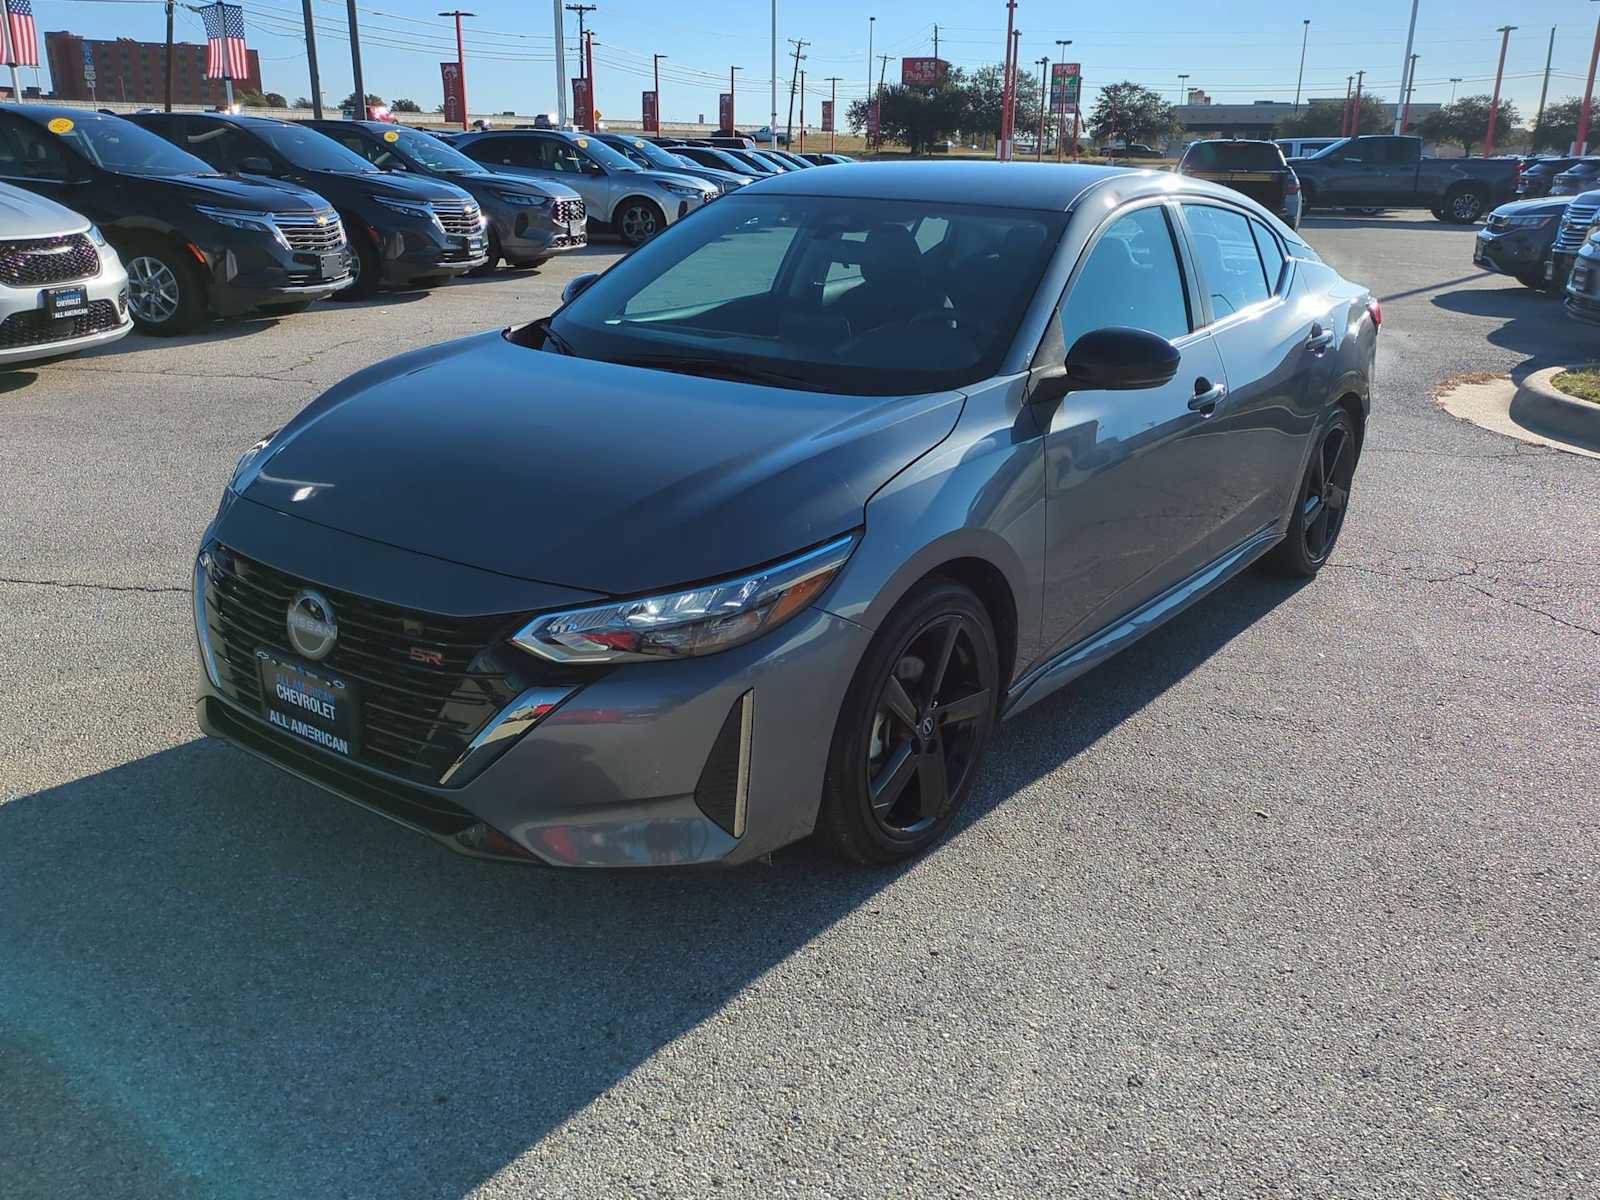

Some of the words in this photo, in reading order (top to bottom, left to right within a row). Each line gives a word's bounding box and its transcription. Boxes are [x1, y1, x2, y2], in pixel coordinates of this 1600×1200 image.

[410, 647, 443, 666] SR
[276, 683, 336, 721] CHEVROLET
[269, 709, 290, 729] ALL
[291, 719, 349, 755] AMERICAN
